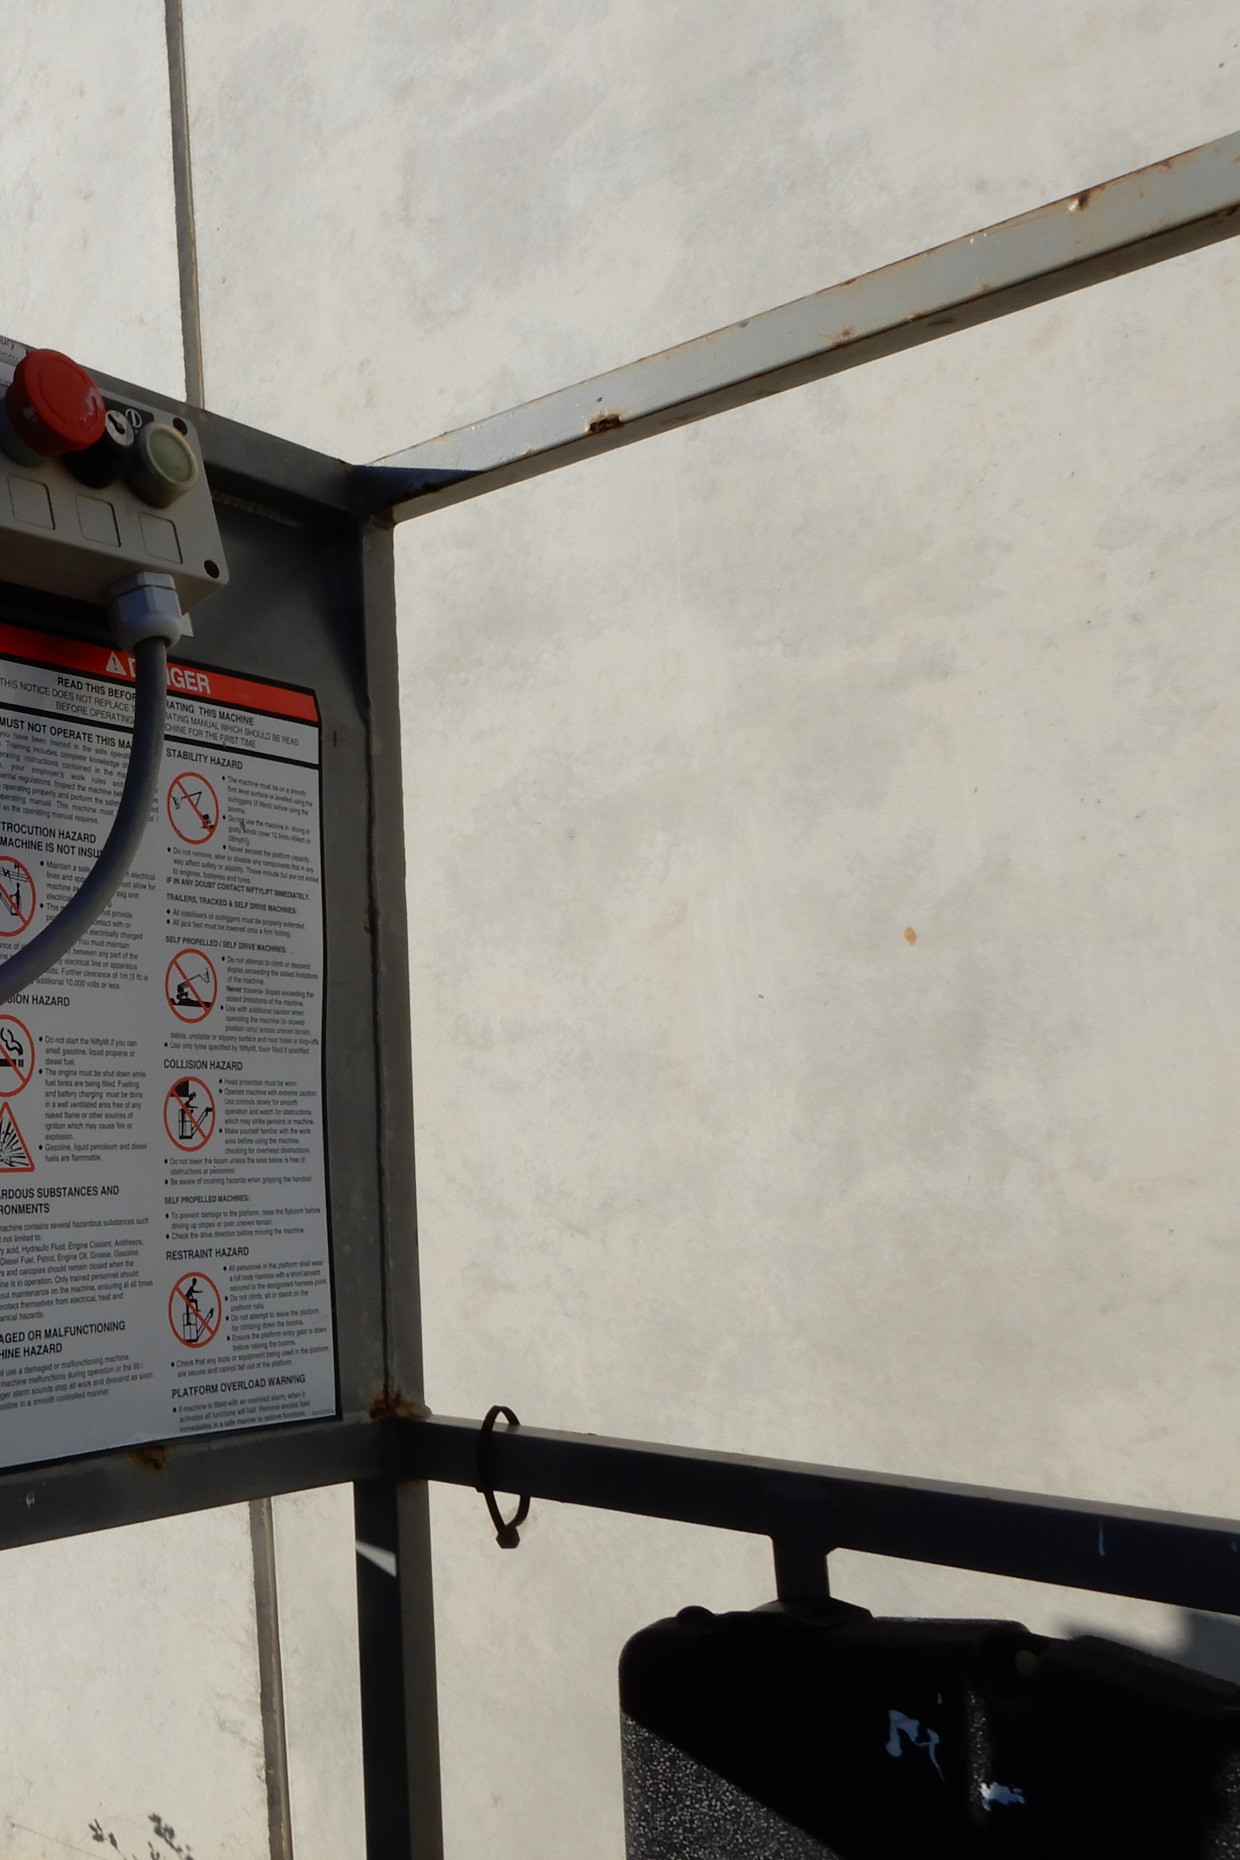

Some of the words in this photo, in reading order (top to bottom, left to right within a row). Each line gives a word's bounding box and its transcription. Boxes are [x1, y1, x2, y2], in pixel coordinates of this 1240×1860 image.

[57, 677, 83, 691] READ
[86, 683, 105, 696] THIS
[199, 707, 217, 719] THIS
[218, 711, 254, 727] MACHINE
[27, 722, 46, 734] NOT
[49, 726, 93, 743] OPERATE
[97, 735, 116, 747] THIS
[166, 747, 208, 764] STABILITY
[210, 756, 244, 771] HAZARD
[58, 829, 96, 844] HAZARD
[0, 836, 43, 852] MACHINE
[45, 843, 54, 853] IS
[56, 844, 75, 856] NOT
[31, 995, 71, 1007] HAZARD
[163, 1059, 208, 1070] COLLISION
[209, 1060, 243, 1071] HAZARD
[37, 1186, 98, 1198] SUBSTANCES
[101, 1185, 120, 1196] AND
[165, 1248, 212, 1261] RESTRAINT
[215, 1246, 249, 1258] HAZARD
[27, 1329, 42, 1341] OR
[44, 1320, 127, 1339] MALFUNCTIONING
[23, 1343, 63, 1357] HAZARD
[171, 1383, 218, 1398] PLATFORM
[220, 1378, 266, 1393] OVERLOAD
[268, 1373, 306, 1387] WARNING
